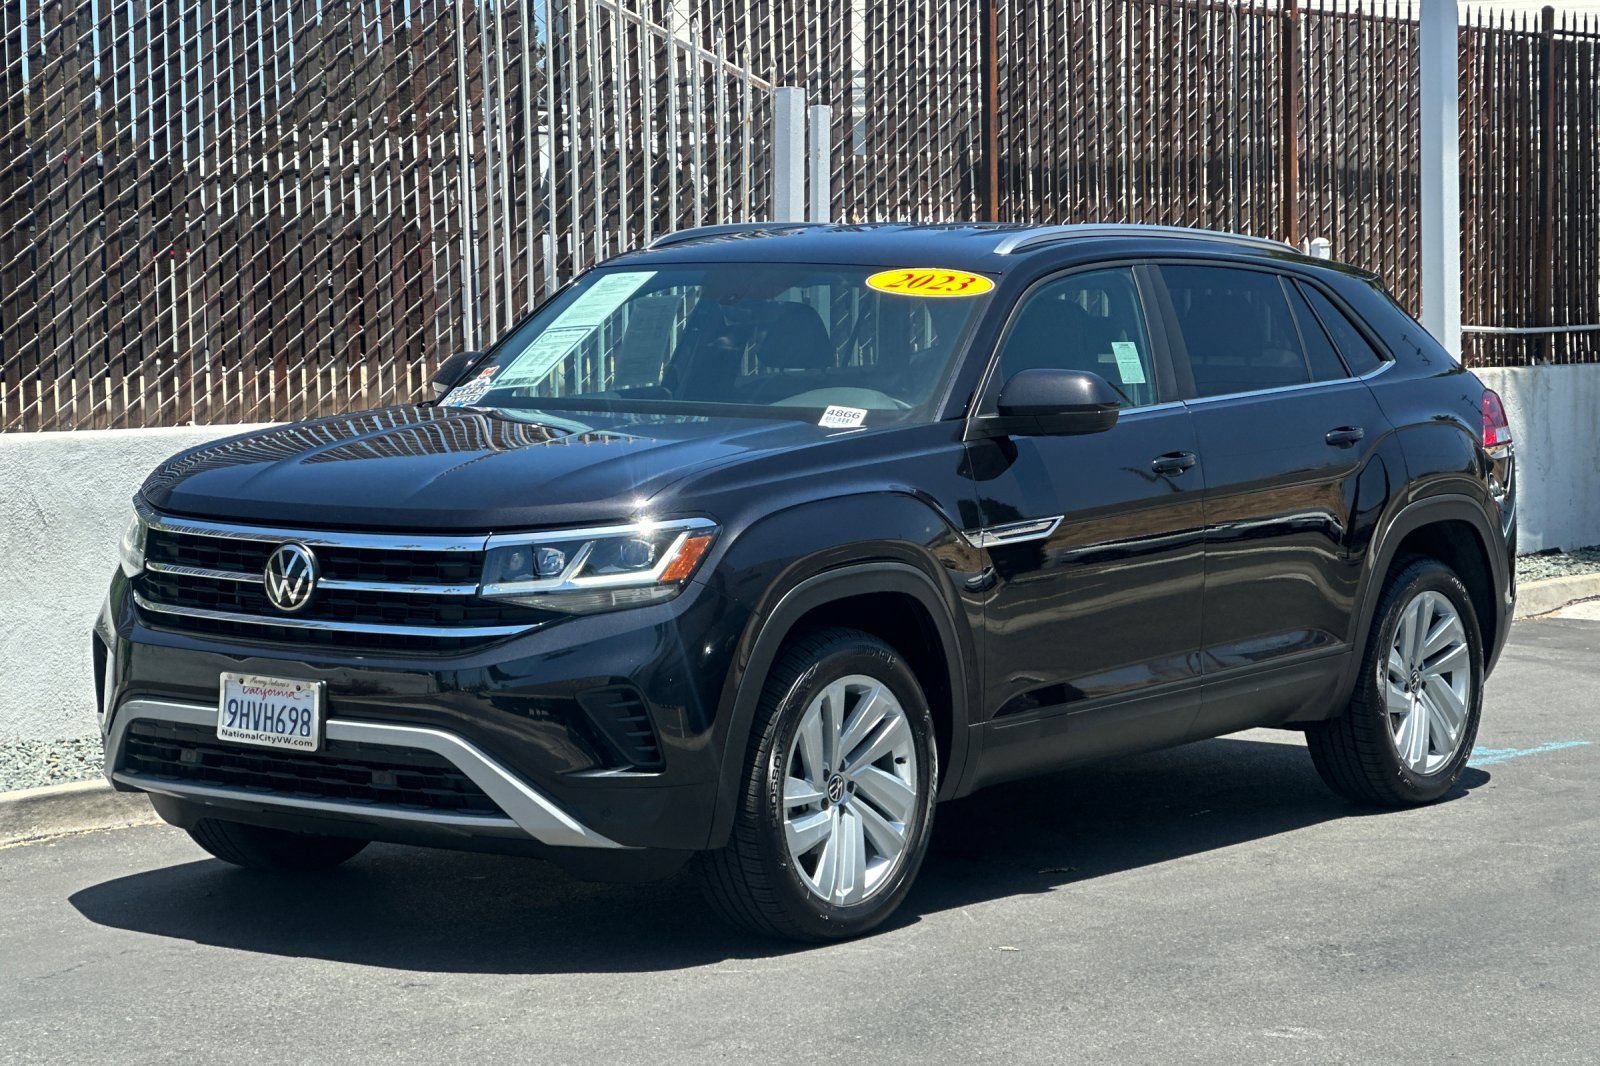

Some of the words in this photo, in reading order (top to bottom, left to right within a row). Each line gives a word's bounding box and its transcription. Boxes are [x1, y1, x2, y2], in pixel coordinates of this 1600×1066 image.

[885, 273, 976, 292] 2023
[826, 409, 861, 420] 4866
[227, 699, 311, 737] 9HVH698
[221, 729, 313, 748] NationalCityVW.com
